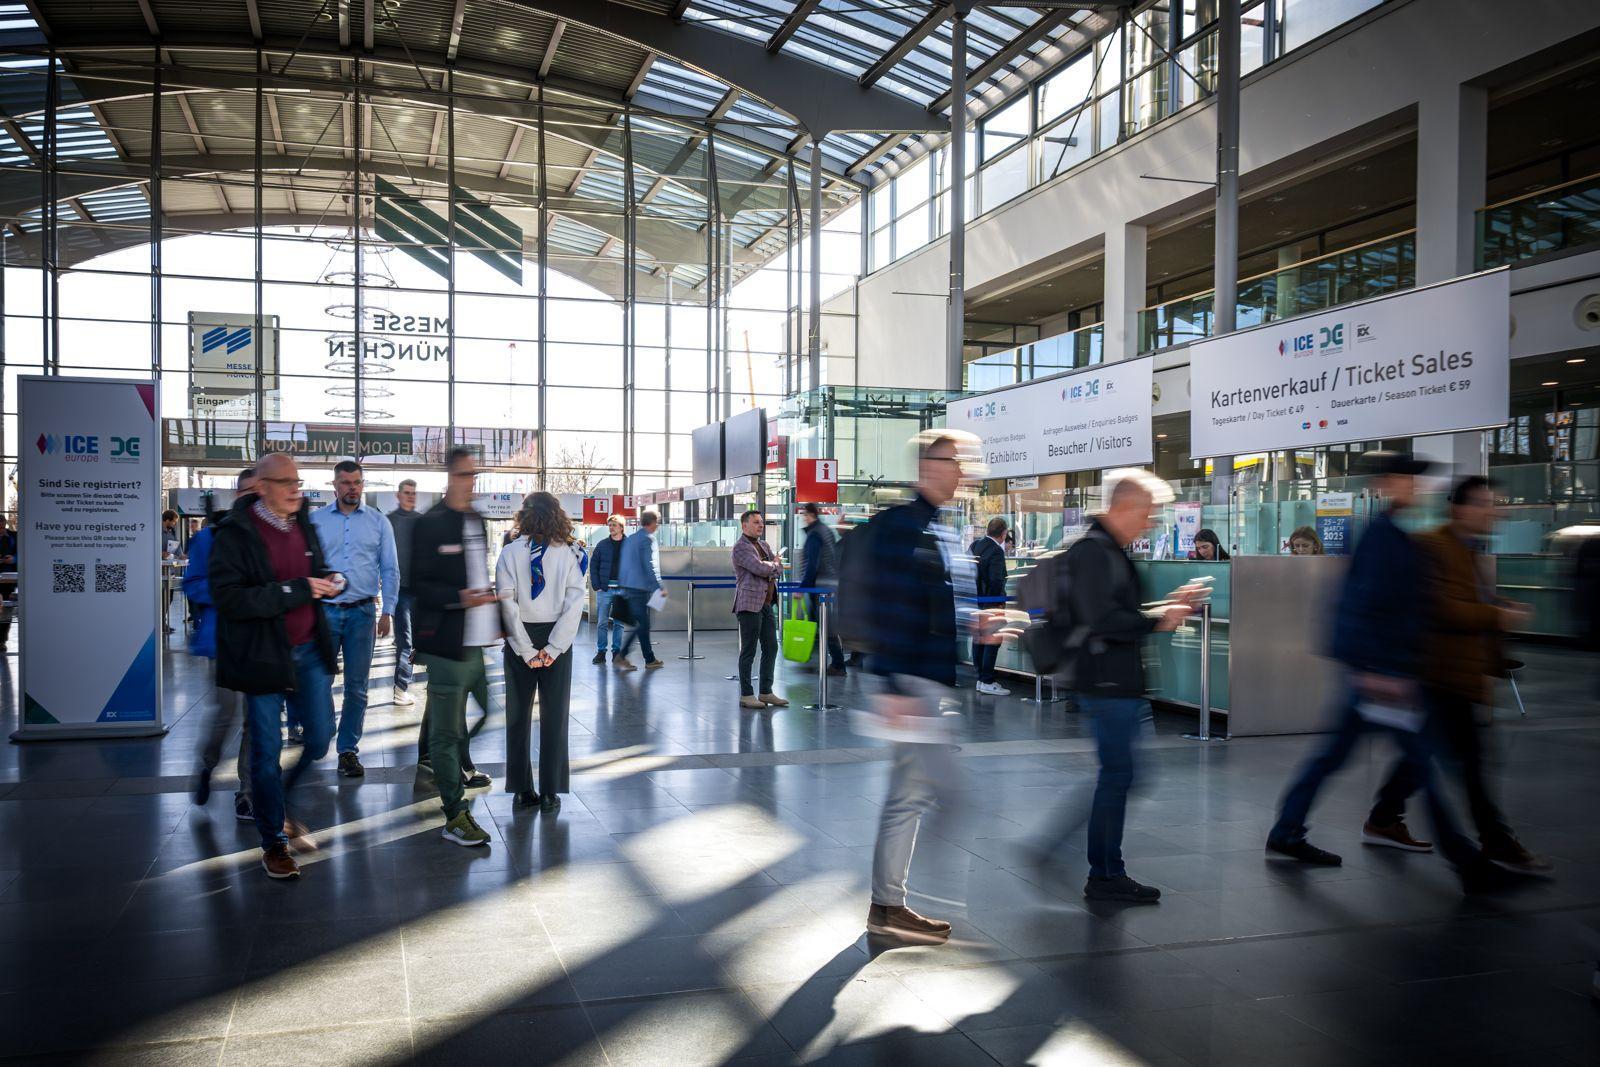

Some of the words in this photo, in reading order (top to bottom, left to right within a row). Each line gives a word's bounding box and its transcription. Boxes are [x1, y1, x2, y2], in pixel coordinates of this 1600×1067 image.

[1293, 333, 1314, 351] ICE
[226, 363, 251, 371] MESSE
[1211, 371, 1328, 408] Kartenverkauf
[1331, 367, 1341, 391] /
[1345, 359, 1405, 387] Ticket
[1411, 350, 1473, 376] Sales
[1070, 386, 1082, 398] ICE
[197, 397, 238, 408] Eingang
[1212, 413, 1246, 426] Tageskarte
[1253, 410, 1265, 421] Day
[1266, 408, 1287, 418] Ticket
[1288, 406, 1294, 415] €
[1295, 404, 1305, 414] 49
[1331, 394, 1377, 409] Dauerkarte
[1384, 390, 1417, 401] Season
[1418, 383, 1447, 396] Ticket
[1449, 381, 1457, 391] €
[1459, 379, 1471, 391] 59
[1043, 427, 1064, 436] Anfragen
[1064, 422, 1087, 432] Ausweise
[1092, 418, 1116, 428] Enquiries
[1118, 414, 1139, 425] Badges
[64, 435, 99, 454] ICE
[1048, 441, 1088, 457] Besucher
[1089, 437, 1094, 453] /
[1095, 436, 1133, 450] Visitors
[65, 453, 99, 463] europe
[990, 450, 1028, 464] Exhibitors
[38, 479, 62, 488] Sind
[64, 480, 80, 488] Sie
[83, 480, 141, 490] registriert?
[35, 522, 61, 531] Have
[63, 523, 81, 533] you
[84, 523, 137, 533] registered
[1323, 532, 1344, 541] 2025
